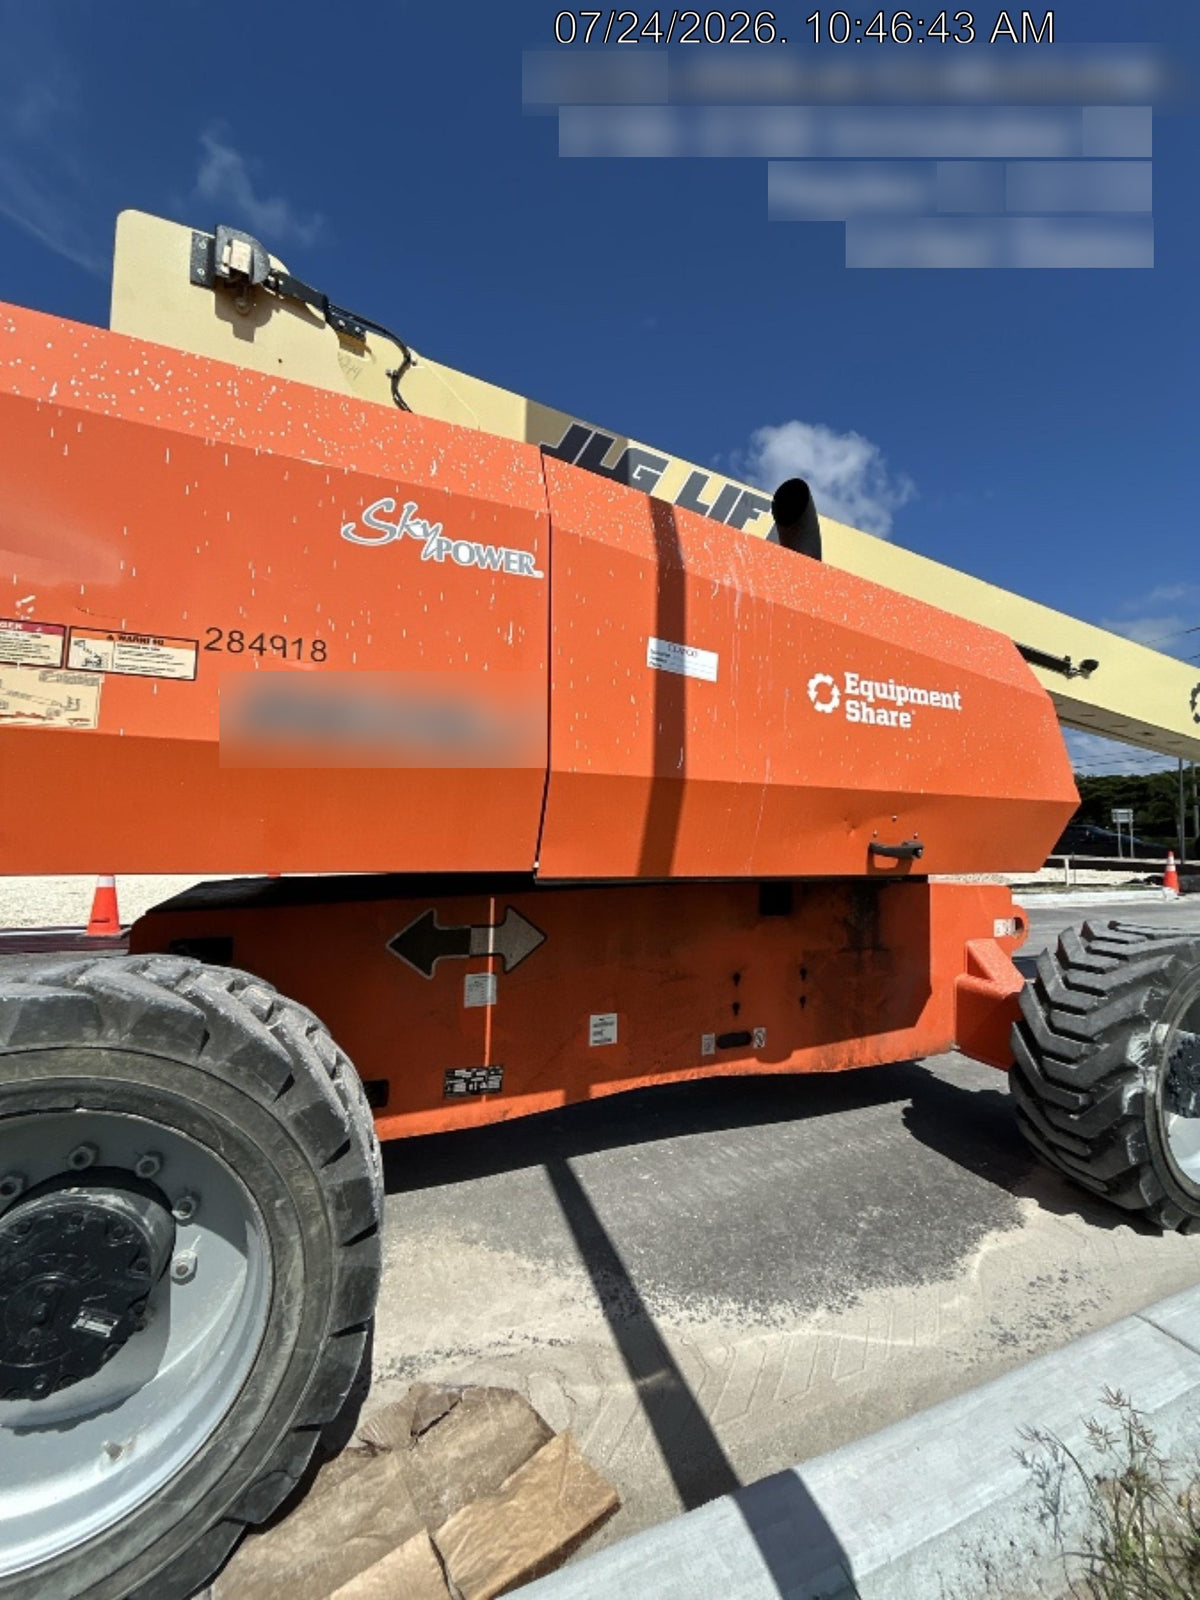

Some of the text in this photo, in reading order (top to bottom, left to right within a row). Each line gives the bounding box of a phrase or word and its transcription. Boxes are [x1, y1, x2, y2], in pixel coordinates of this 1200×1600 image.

[540, 421, 780, 545] JLG LIF
[203, 626, 328, 662] 284918
[844, 671, 963, 711] Equipment
[845, 700, 912, 728] Share
